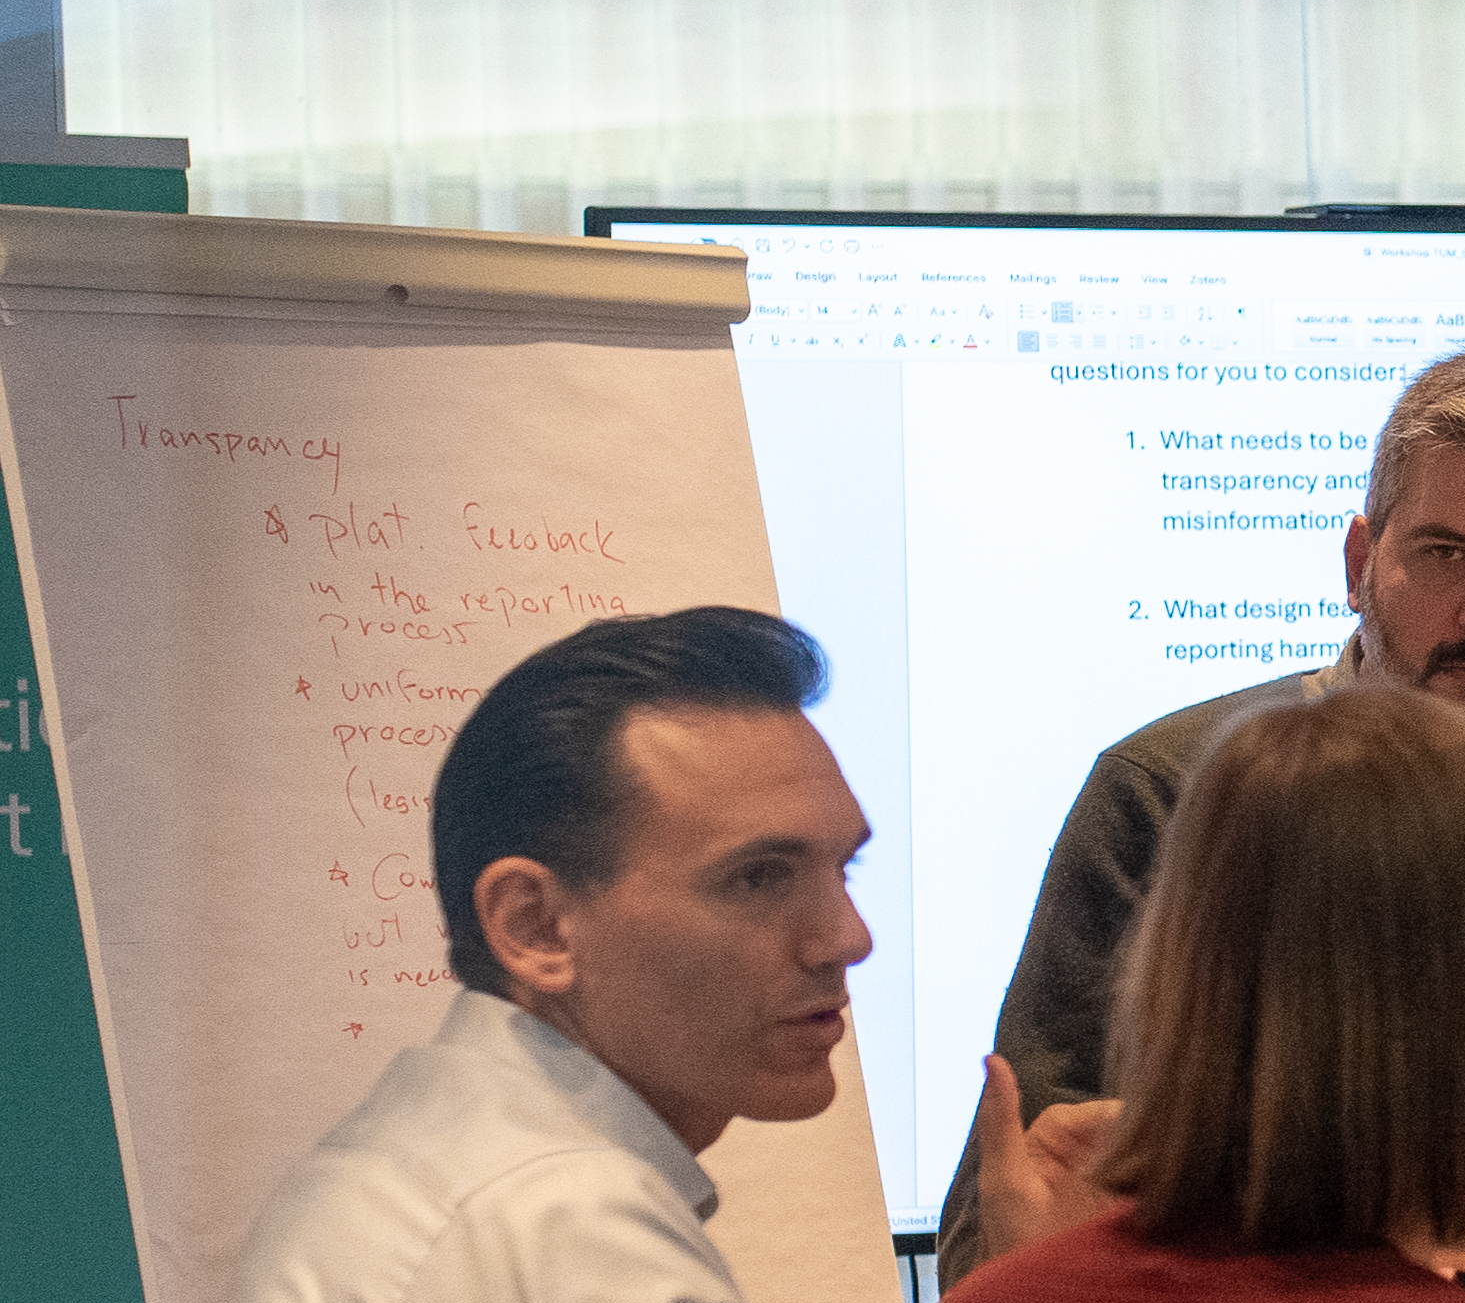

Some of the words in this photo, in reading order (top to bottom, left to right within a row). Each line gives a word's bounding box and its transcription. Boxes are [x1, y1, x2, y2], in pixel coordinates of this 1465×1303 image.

[795, 271, 837, 284] Design
[858, 272, 898, 284] Layout
[921, 272, 987, 284] References
[1009, 273, 1058, 286] Mailings
[1079, 274, 1120, 285] Review
[1141, 274, 1169, 285] View
[1050, 362, 1170, 385] questions
[1177, 362, 1208, 381] for
[1214, 366, 1257, 386] you
[1265, 364, 1288, 381] to
[1126, 430, 1146, 450] 1.
[1160, 430, 1223, 450] What
[1231, 430, 1303, 450] needs
[1310, 433, 1333, 450] to
[1340, 430, 1368, 450] be
[1161, 473, 1318, 495] transparency
[1325, 470, 1368, 490] and
[370, 572, 432, 615] the
[1128, 600, 1149, 620] 2.
[1164, 599, 1227, 619] What
[1234, 599, 1312, 623] design
[1165, 640, 1274, 664] reporting
